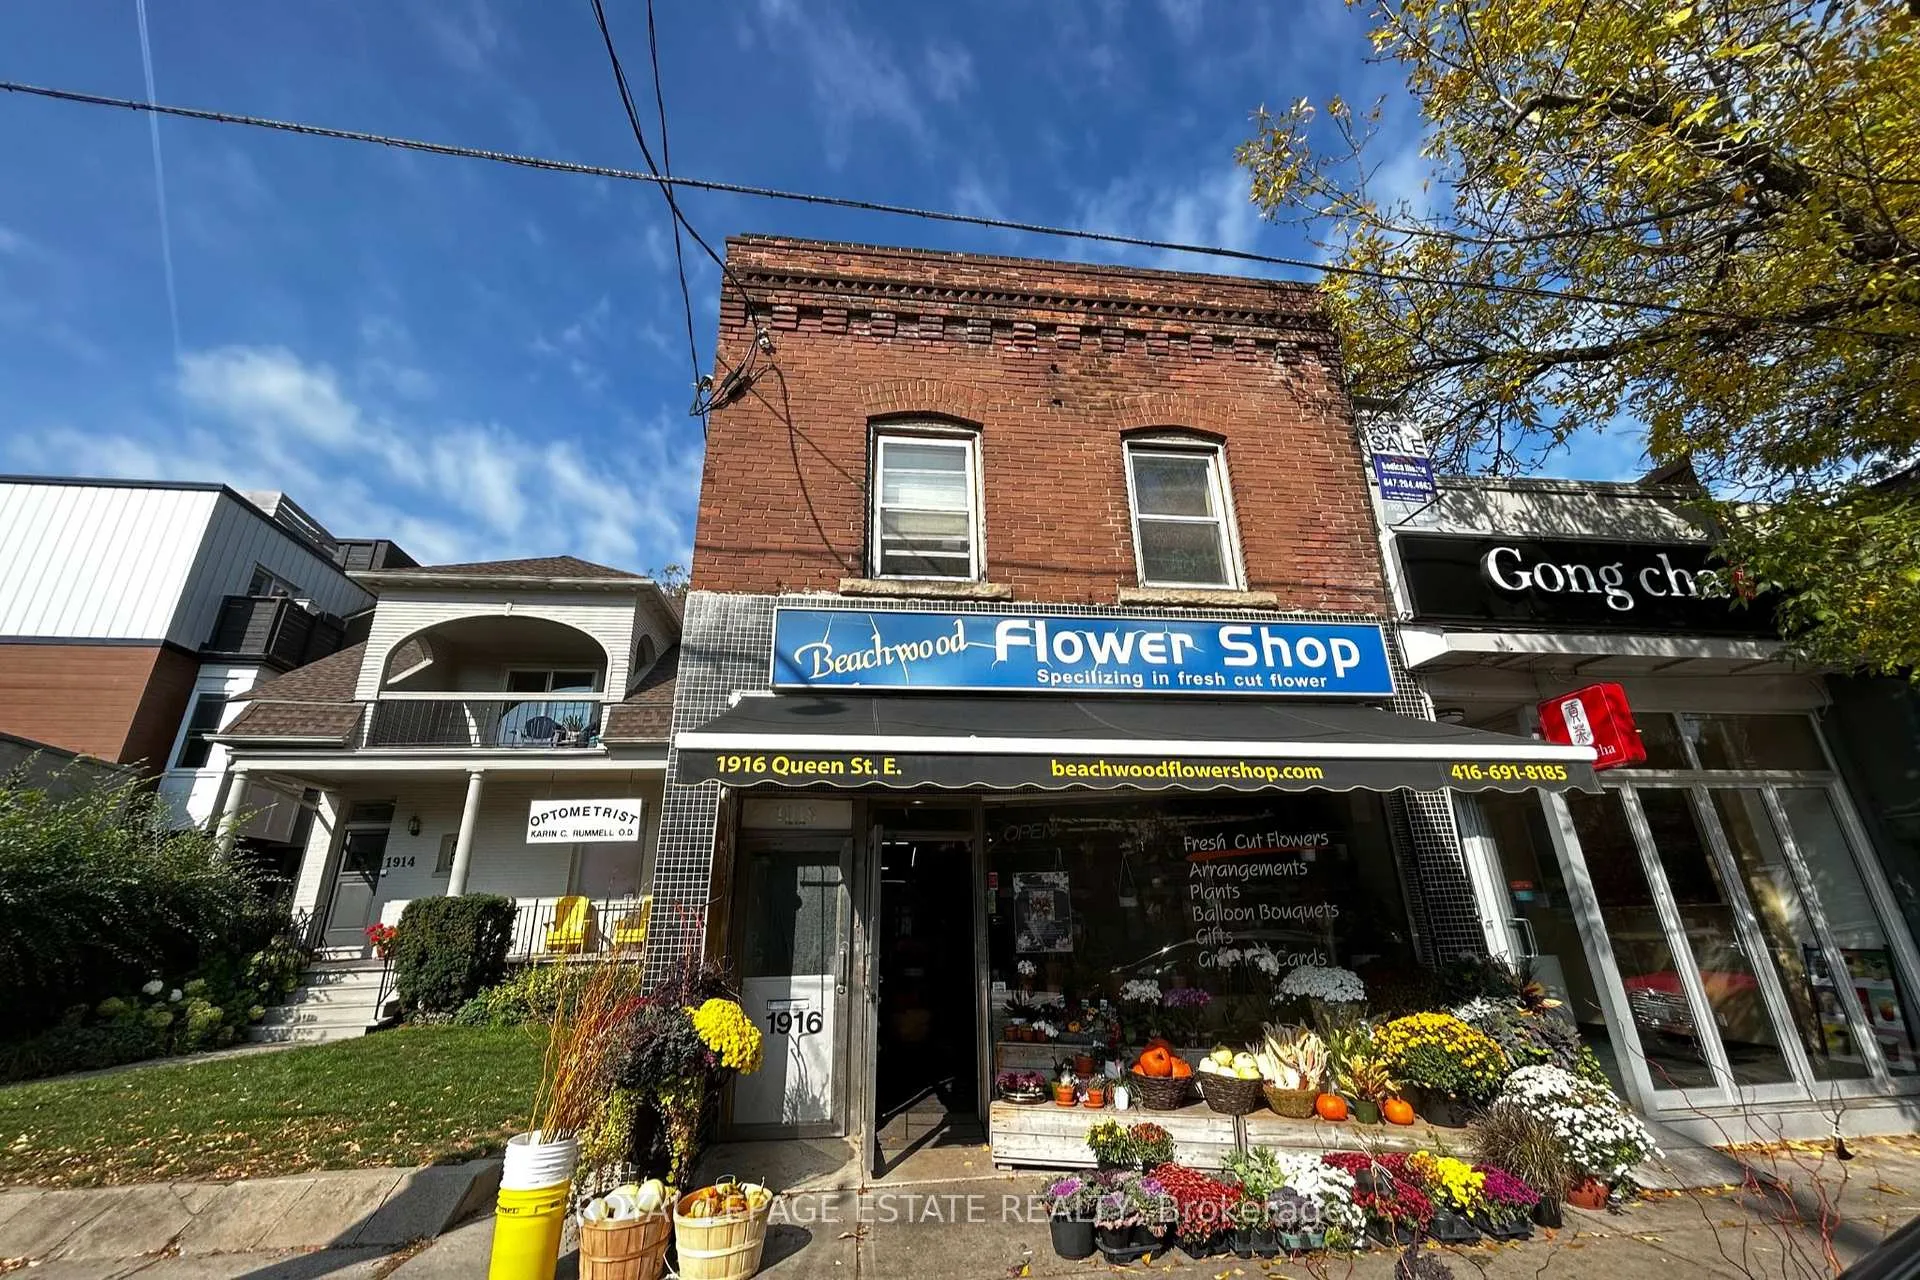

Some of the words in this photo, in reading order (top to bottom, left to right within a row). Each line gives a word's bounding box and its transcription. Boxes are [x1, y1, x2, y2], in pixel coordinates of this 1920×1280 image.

[1371, 436, 1425, 455] SALE
[1487, 547, 1635, 611] Gong
[1639, 553, 1731, 600] cha
[794, 618, 968, 679] Beachwood
[995, 619, 1195, 665] Flower
[1218, 625, 1361, 678] Shop
[1036, 668, 1144, 688] Specilizing
[1152, 670, 1169, 685] in
[1177, 671, 1226, 687] fresh
[1234, 673, 1264, 687] cut
[1270, 673, 1327, 688] flower
[1597, 743, 1616, 757] ha
[716, 756, 767, 773] 1916
[771, 757, 845, 776] Queen
[850, 757, 879, 775] St.
[883, 758, 903, 775] E.
[1051, 759, 1325, 782] beachwoodflowershop.com
[1451, 764, 1568, 780] 416-691-8185
[530, 806, 638, 826] OPTOMETRIST
[530, 829, 557, 838] KARIN
[572, 828, 615, 837] RUMMELL
[1003, 823, 1057, 842] OPEN
[1184, 832, 1227, 852] Fresh
[1234, 833, 1263, 849] Cut
[1267, 831, 1329, 848] Flowers
[386, 856, 416, 868] 1914
[1189, 861, 1309, 882] Arrangements
[1190, 884, 1241, 900] Plants
[1193, 904, 1255, 922] Balloon
[1259, 902, 1340, 924] Bouquets
[1195, 926, 1234, 945] Gifts
[1276, 948, 1328, 967] Cards
[766, 1011, 822, 1034] 1916
